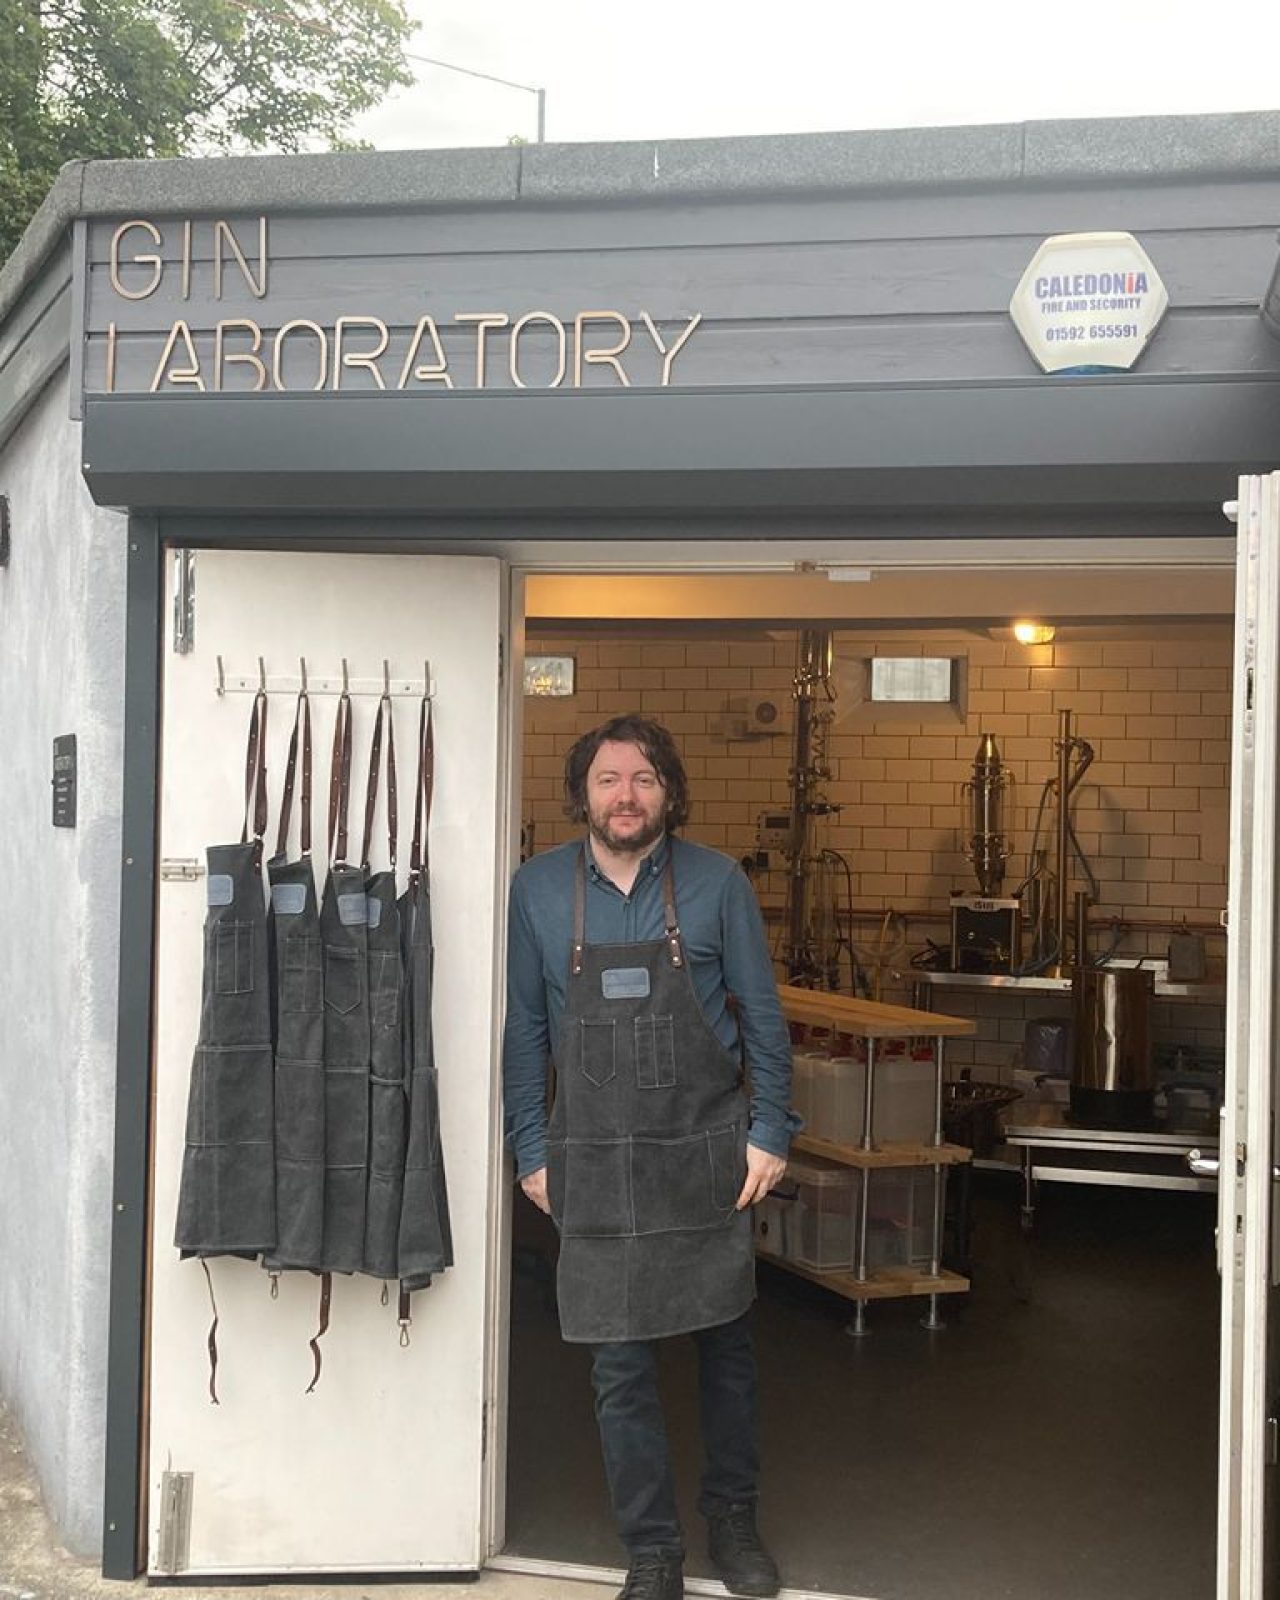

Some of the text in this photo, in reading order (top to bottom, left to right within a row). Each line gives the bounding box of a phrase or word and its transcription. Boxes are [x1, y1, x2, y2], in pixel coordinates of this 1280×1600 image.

[110, 216, 268, 300] GIN
[1041, 297, 1141, 314] FIRE AND SECURITY
[1046, 324, 1138, 341] 01592 655591
